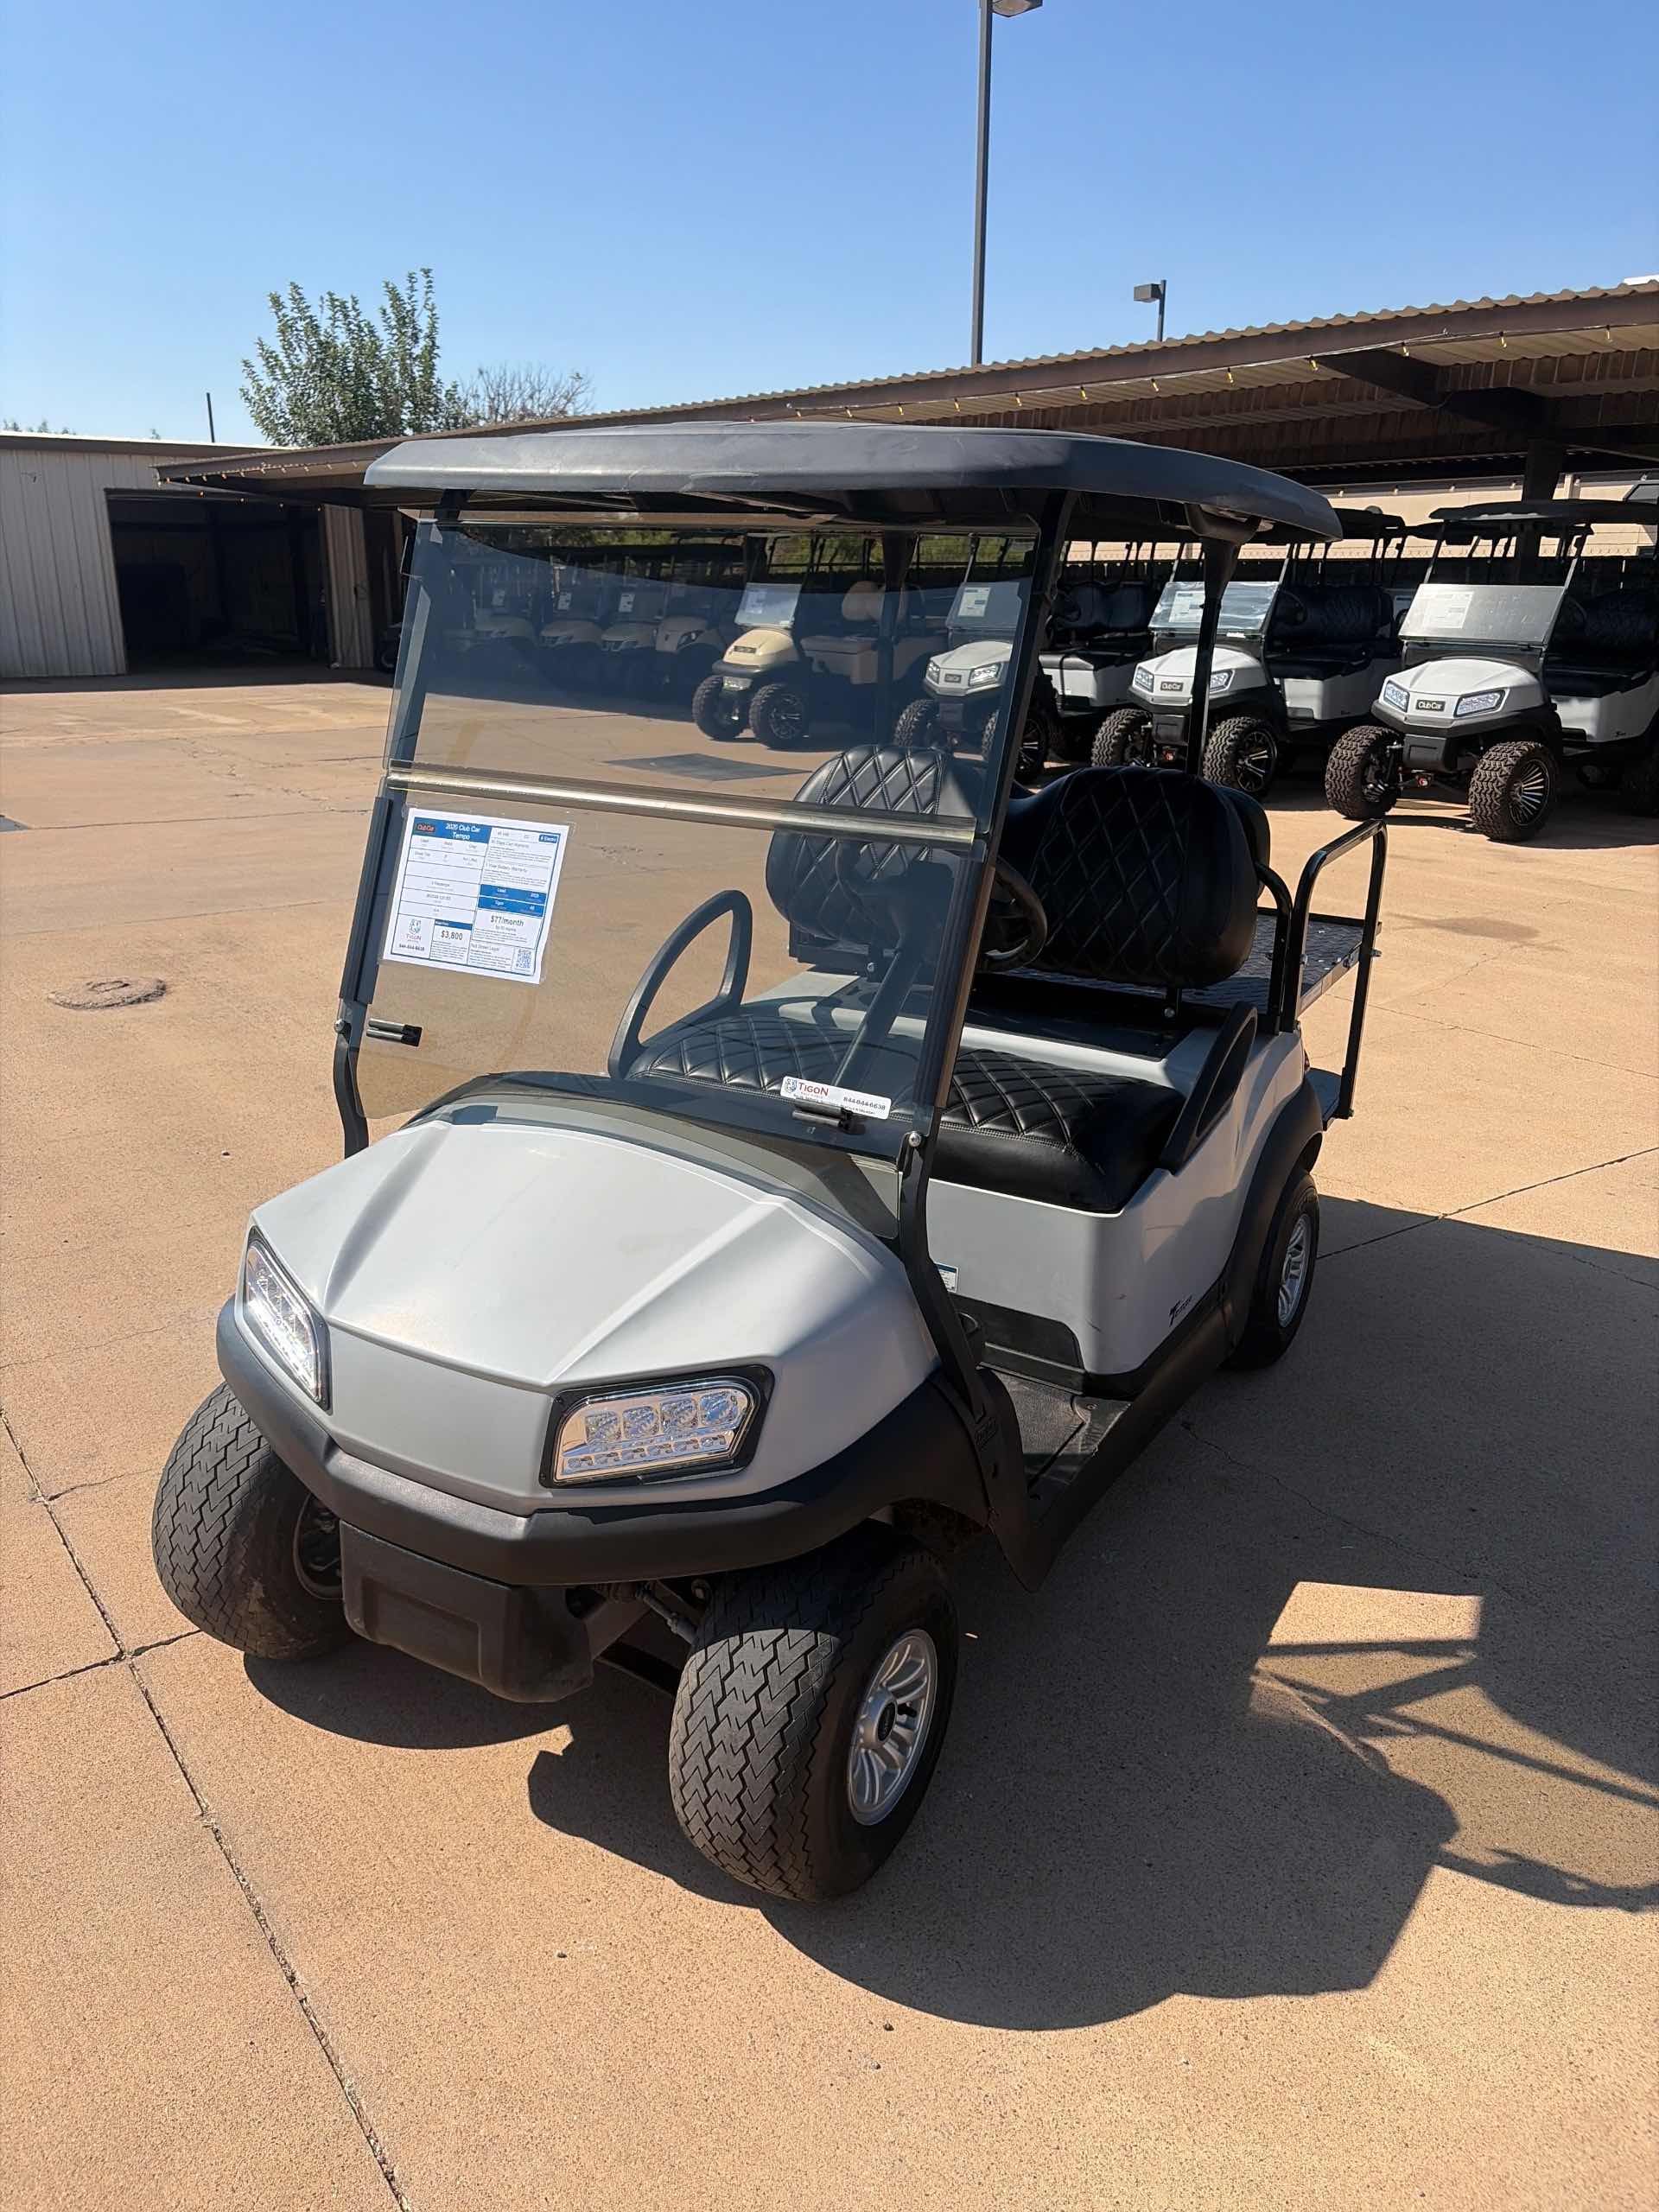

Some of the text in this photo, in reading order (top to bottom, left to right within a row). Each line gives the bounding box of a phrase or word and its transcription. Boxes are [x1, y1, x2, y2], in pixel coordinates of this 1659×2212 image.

[491, 915, 524, 927] $77/month
[441, 931, 463, 940] $3,800
[798, 1082, 830, 1096] TIGON
